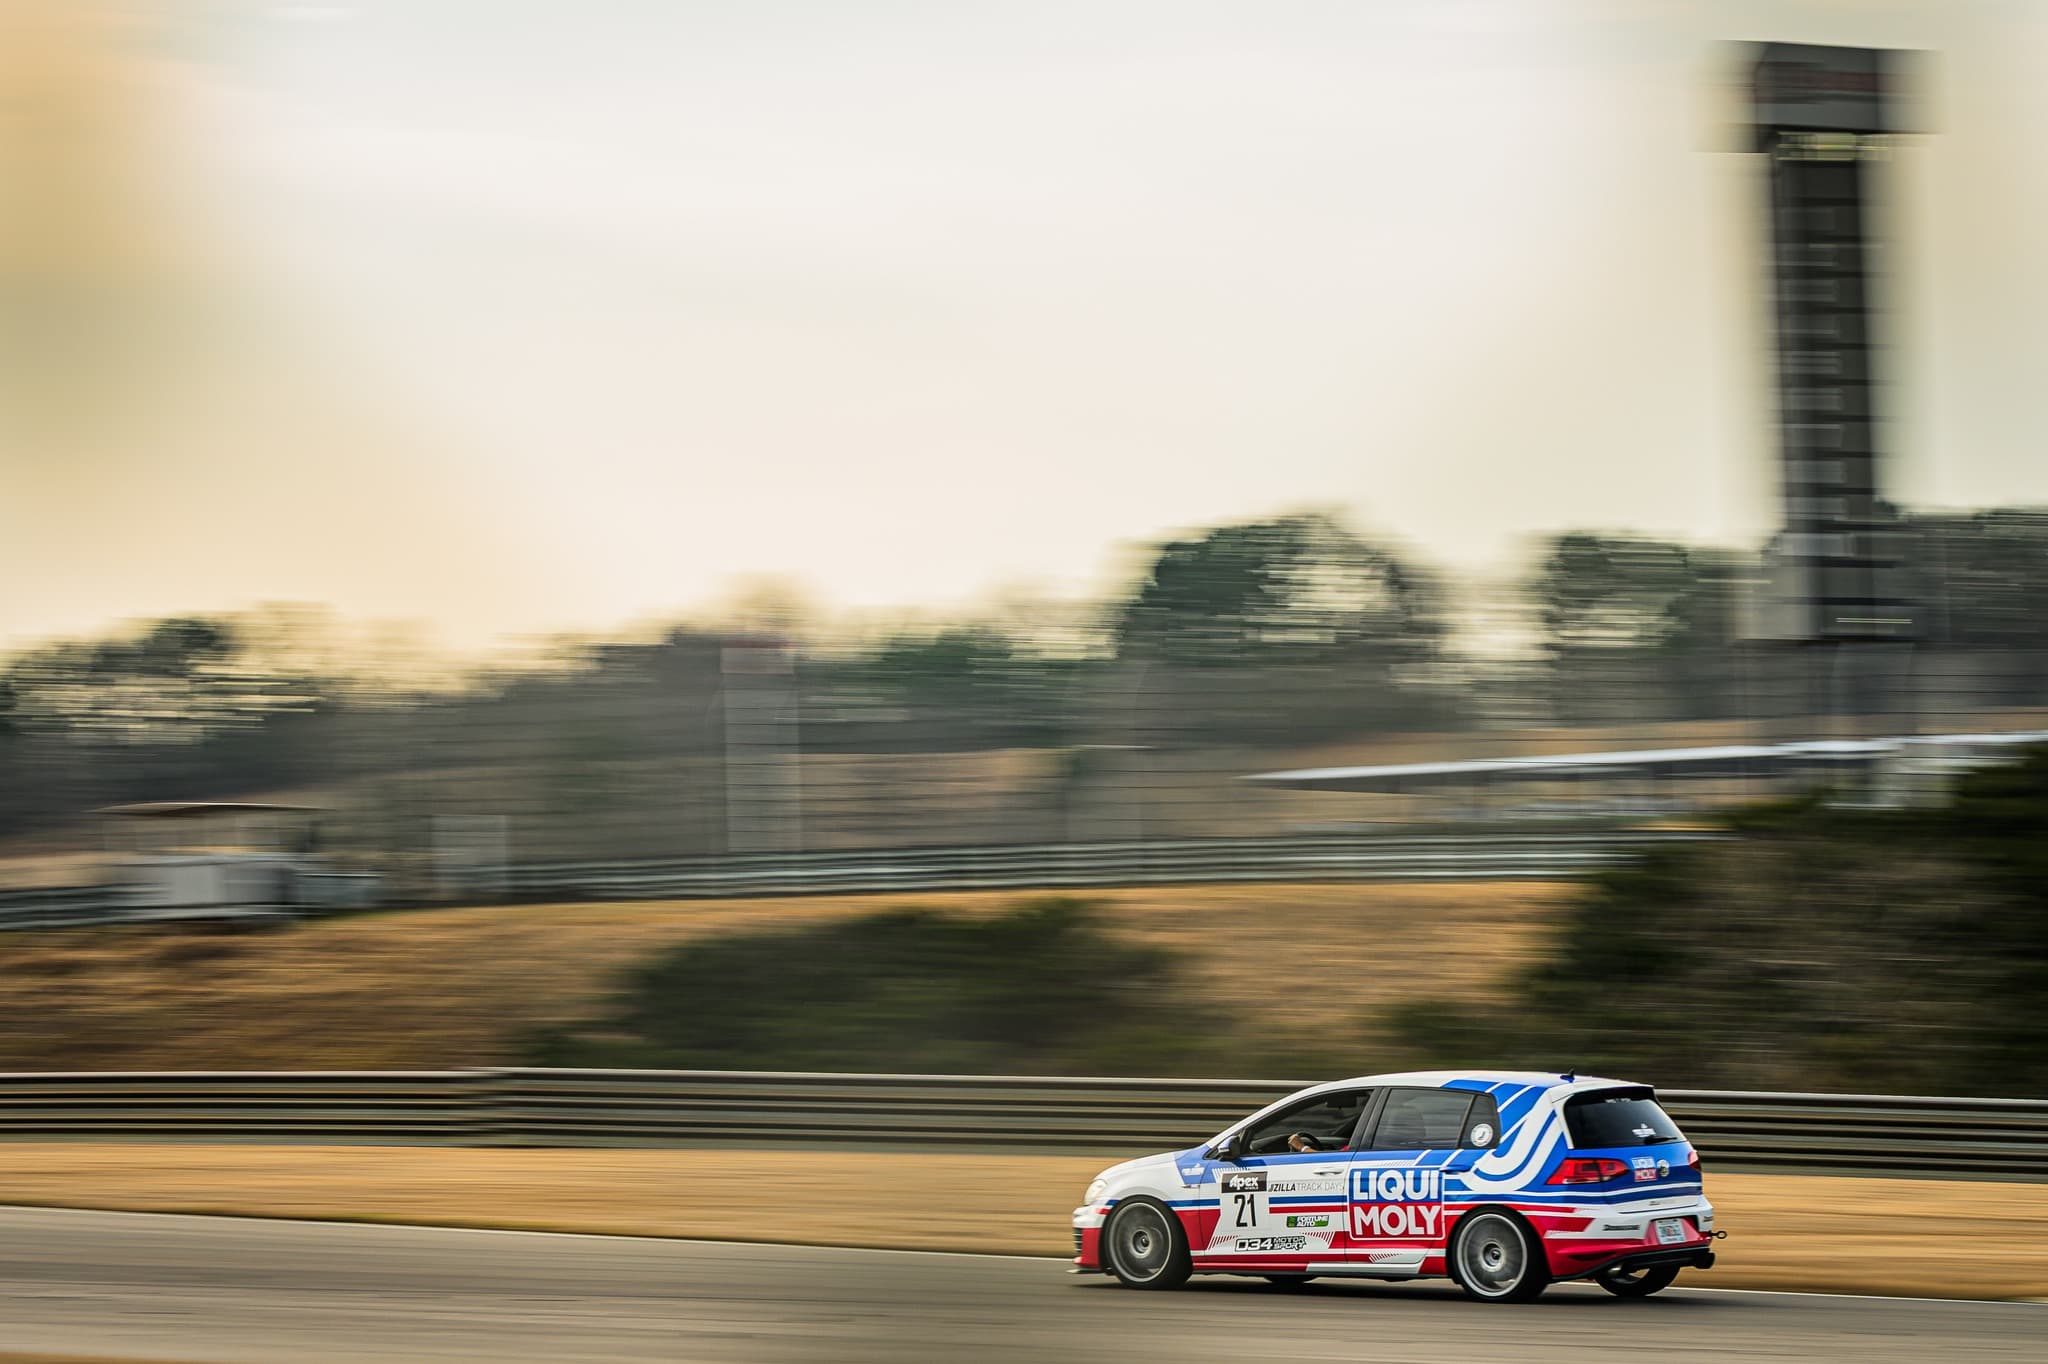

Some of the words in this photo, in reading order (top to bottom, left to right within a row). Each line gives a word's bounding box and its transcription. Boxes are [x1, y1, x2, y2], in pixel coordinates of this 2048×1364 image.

[1229, 1174, 1258, 1190] Apex
[1353, 1170, 1439, 1201] LIQUI
[1234, 1194, 1256, 1227] 21
[1353, 1205, 1441, 1236] MOLY
